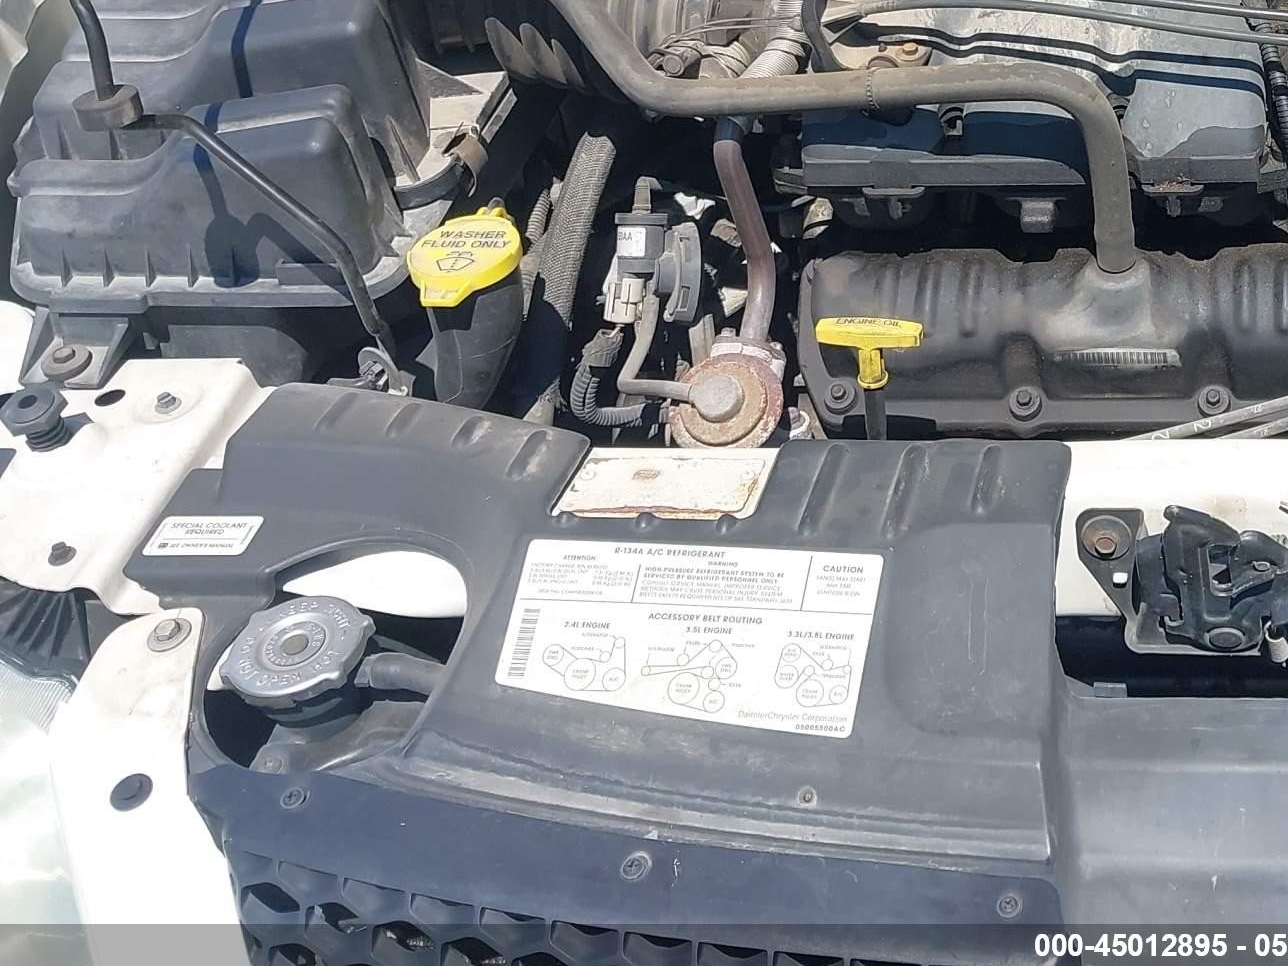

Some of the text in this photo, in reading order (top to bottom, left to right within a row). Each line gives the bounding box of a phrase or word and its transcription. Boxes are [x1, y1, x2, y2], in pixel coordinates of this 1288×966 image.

[440, 231, 506, 239] WASHER
[614, 547, 726, 558] R-134A A/C REFRIGERANT
[823, 565, 864, 574] CAUTION
[648, 613, 763, 624] ACCESSORY BELT ROUTING
[738, 710, 848, 723] DaimlerChrysler Corporation
